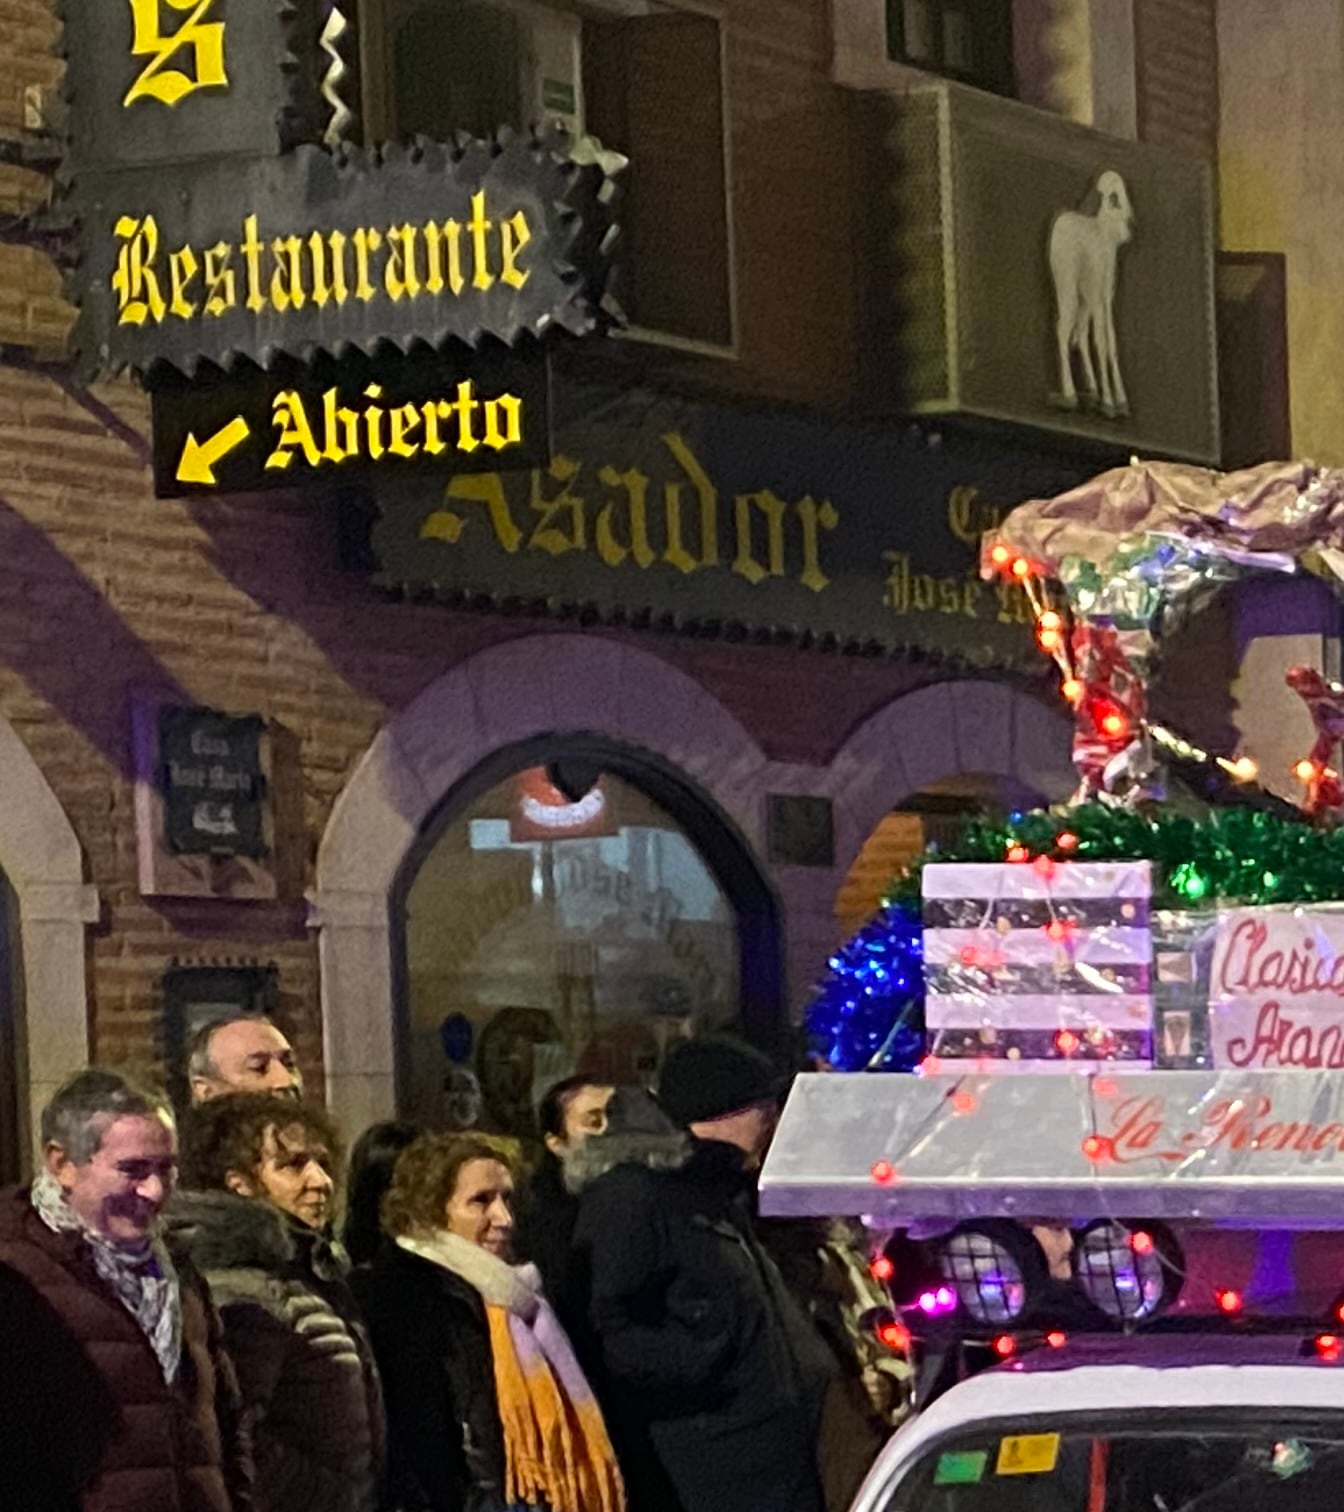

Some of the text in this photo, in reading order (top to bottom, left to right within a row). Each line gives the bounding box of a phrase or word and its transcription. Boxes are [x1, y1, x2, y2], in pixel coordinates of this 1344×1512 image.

[112, 190, 532, 328] Restaurante
[264, 378, 523, 474] Abierto
[421, 432, 840, 593] Asador
[1110, 1095, 1187, 1164] La
